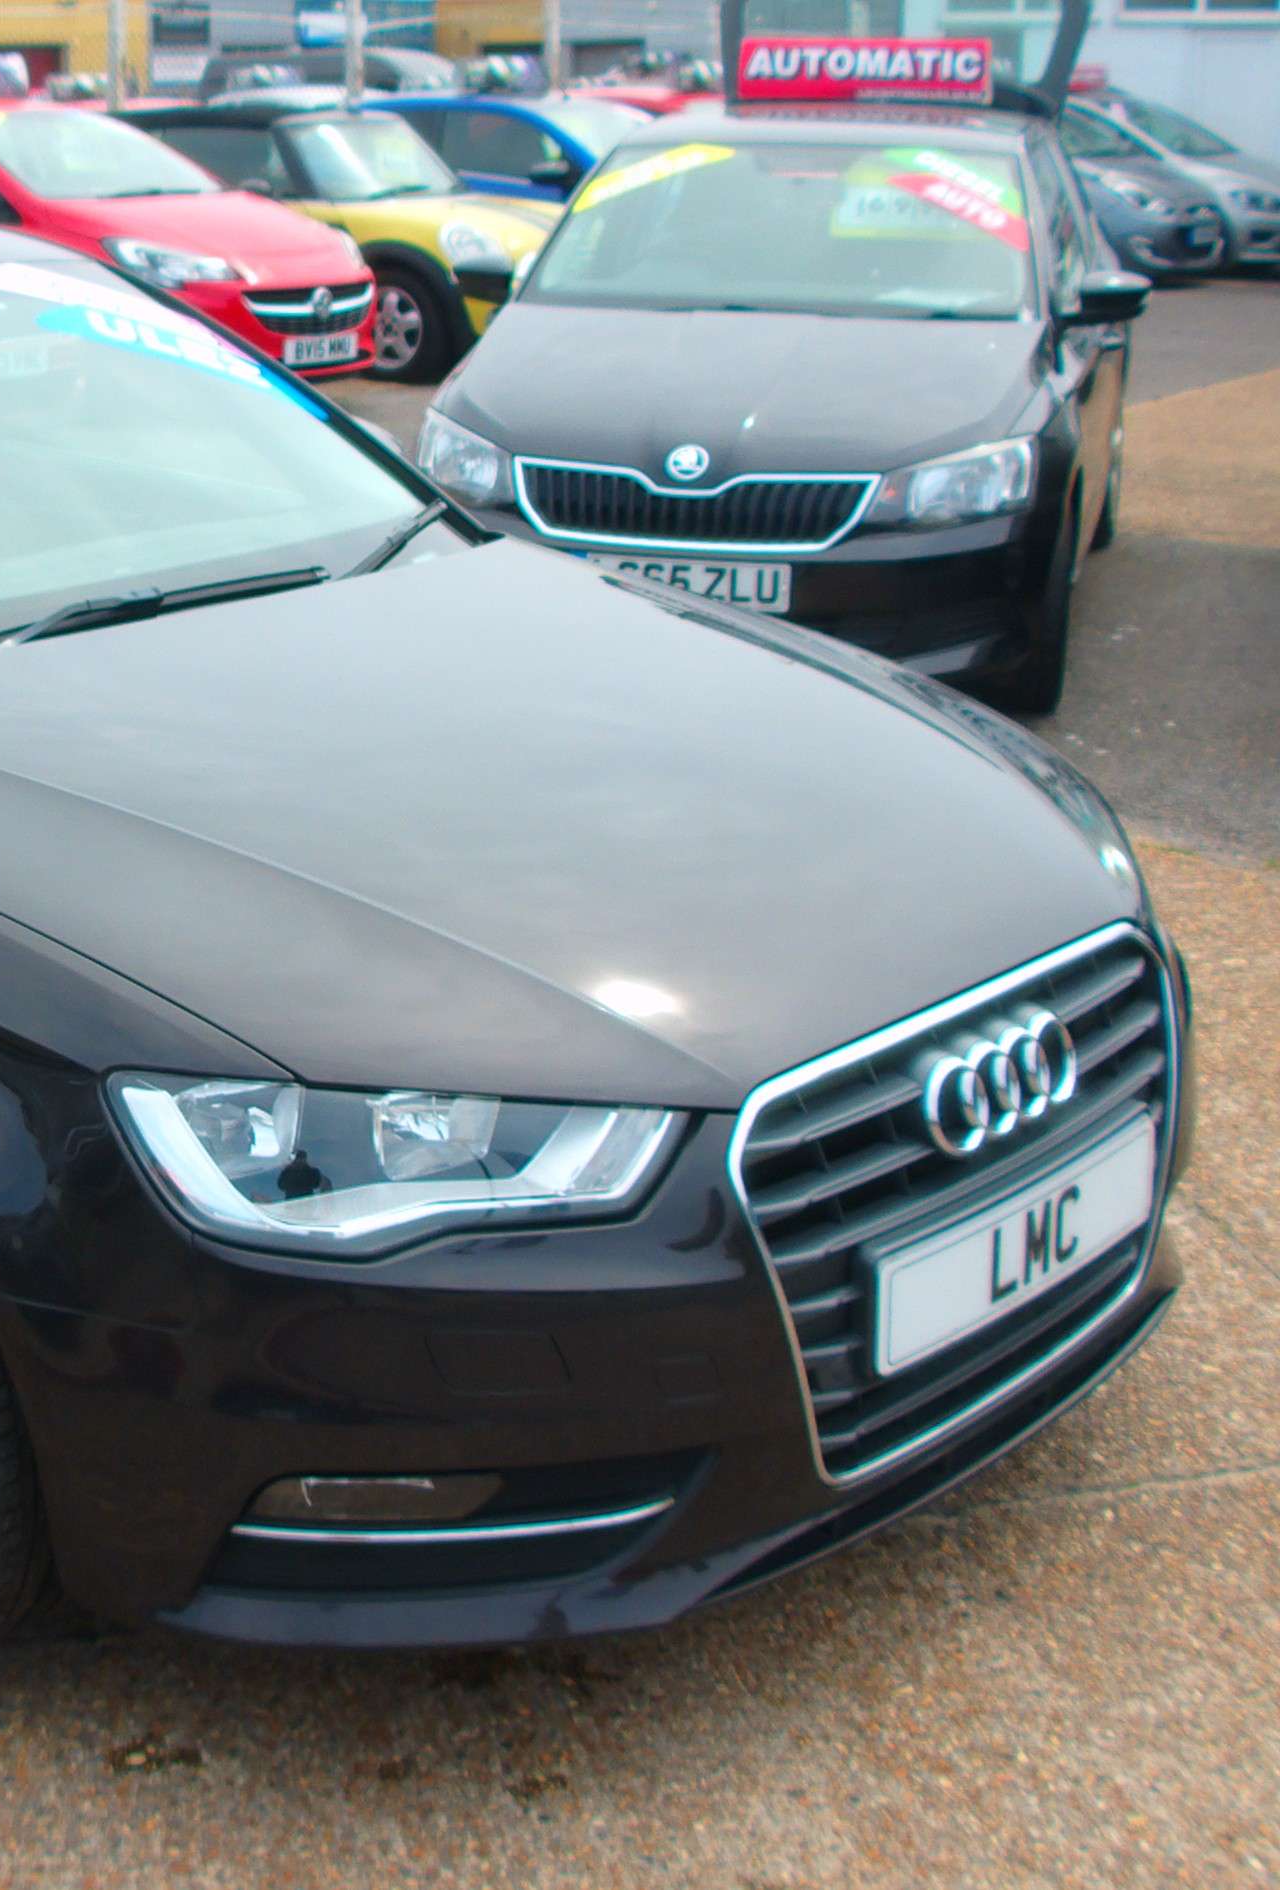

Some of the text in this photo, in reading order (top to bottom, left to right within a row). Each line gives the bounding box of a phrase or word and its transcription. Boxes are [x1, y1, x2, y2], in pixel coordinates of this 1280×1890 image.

[748, 47, 983, 81] AUTOMATIC
[925, 182, 1008, 229] AUTO
[704, 566, 779, 604] ZLU
[991, 1184, 1081, 1303] LMC
